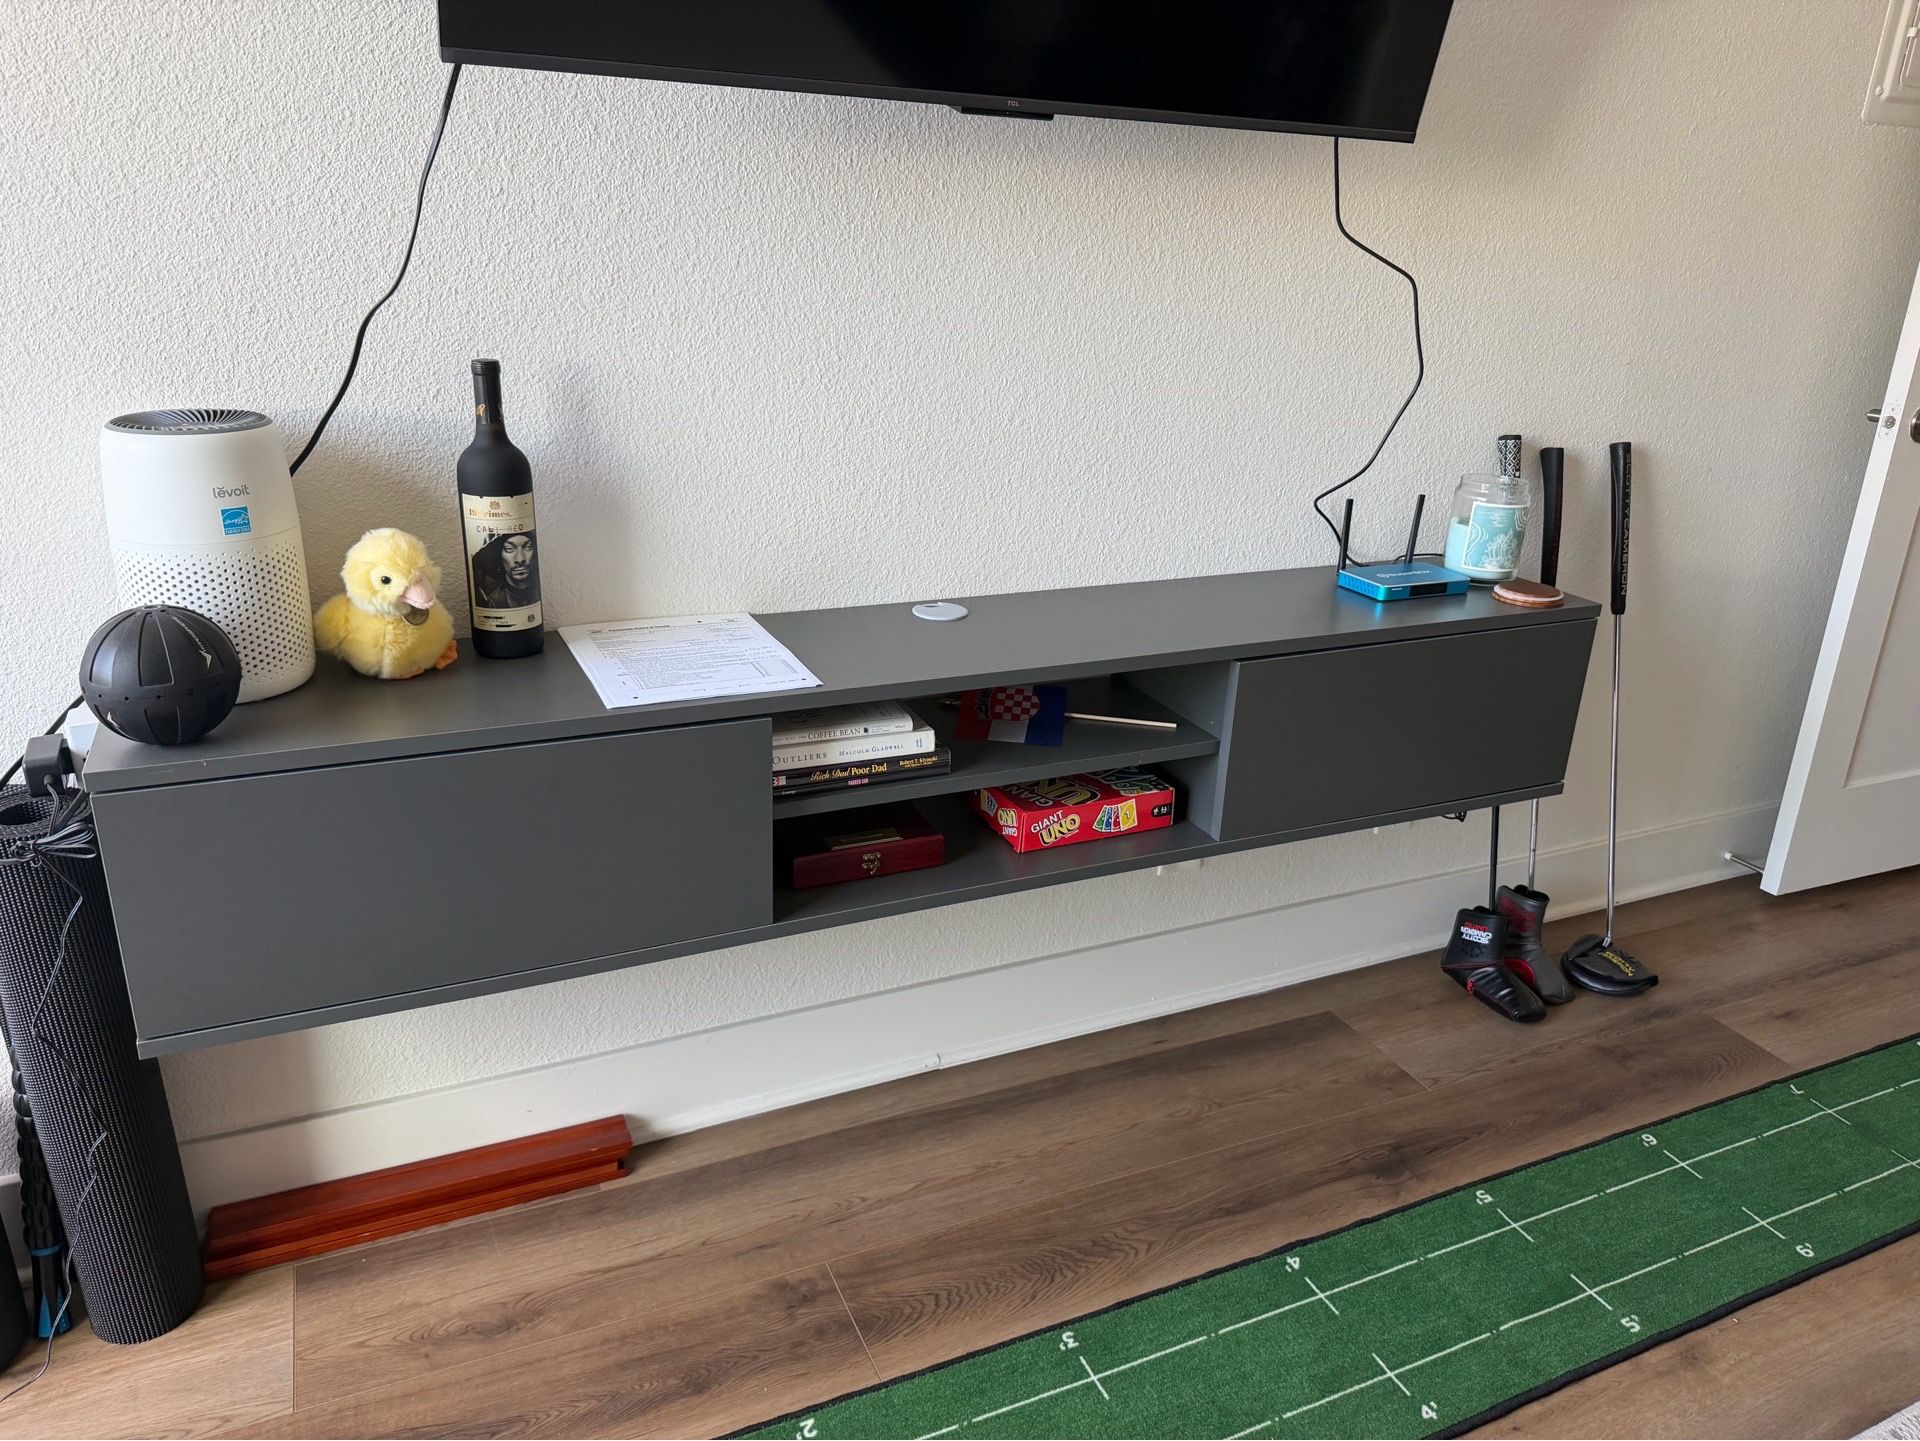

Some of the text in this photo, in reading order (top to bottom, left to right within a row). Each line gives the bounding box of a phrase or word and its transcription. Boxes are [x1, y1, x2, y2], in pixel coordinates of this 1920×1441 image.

[1621, 518, 1630, 595] CAMERON
[807, 729, 838, 740] COFFEE
[839, 727, 861, 737] BEAN
[772, 743, 904, 765] OUTLIERS MALCOLM GLADWELL
[810, 770, 830, 781] Rich
[851, 766, 869, 776] Poor
[871, 763, 887, 773] Dad
[997, 808, 1018, 827] UNO
[1031, 810, 1064, 833] GIANT
[1002, 826, 1018, 837] GIANT
[1039, 812, 1081, 847] UNO
[1461, 933, 1489, 944] SCOTTY
